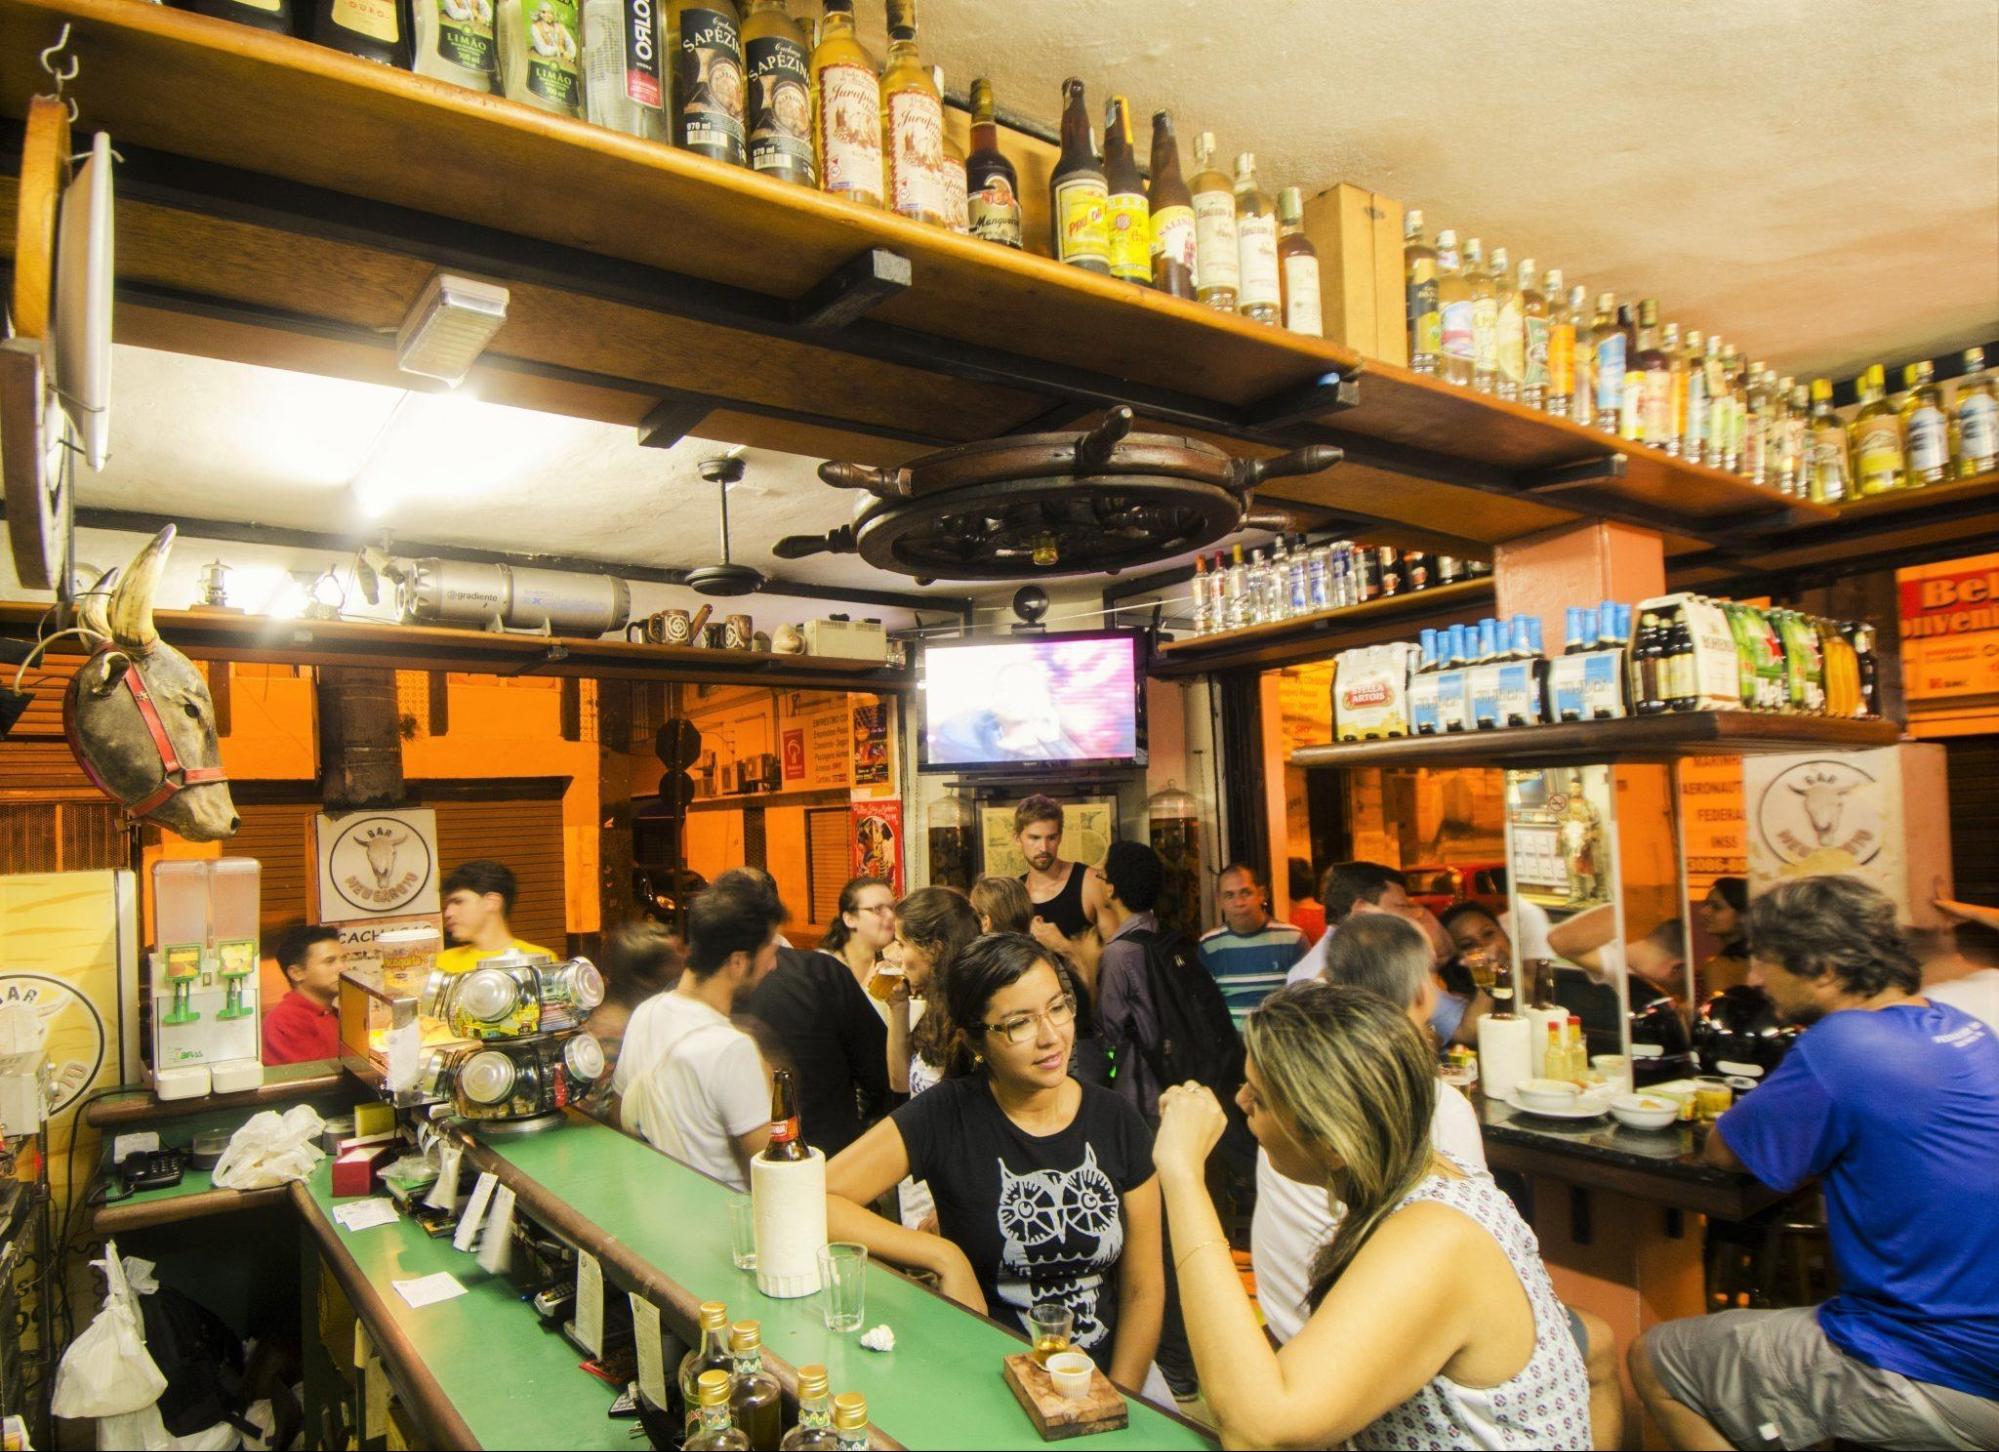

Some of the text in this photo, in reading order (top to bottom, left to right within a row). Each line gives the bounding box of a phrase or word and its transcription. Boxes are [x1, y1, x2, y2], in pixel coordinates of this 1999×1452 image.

[633, 0, 652, 61] ORLO
[447, 32, 486, 51] LIMÃO
[535, 67, 571, 85] LIMÃO
[457, 591, 499, 602] gradiente
[1351, 691, 1386, 703] ARTOIS
[1804, 772, 1836, 785] BAR
[367, 827, 392, 839] BAR
[0, 985, 38, 1003] AR
